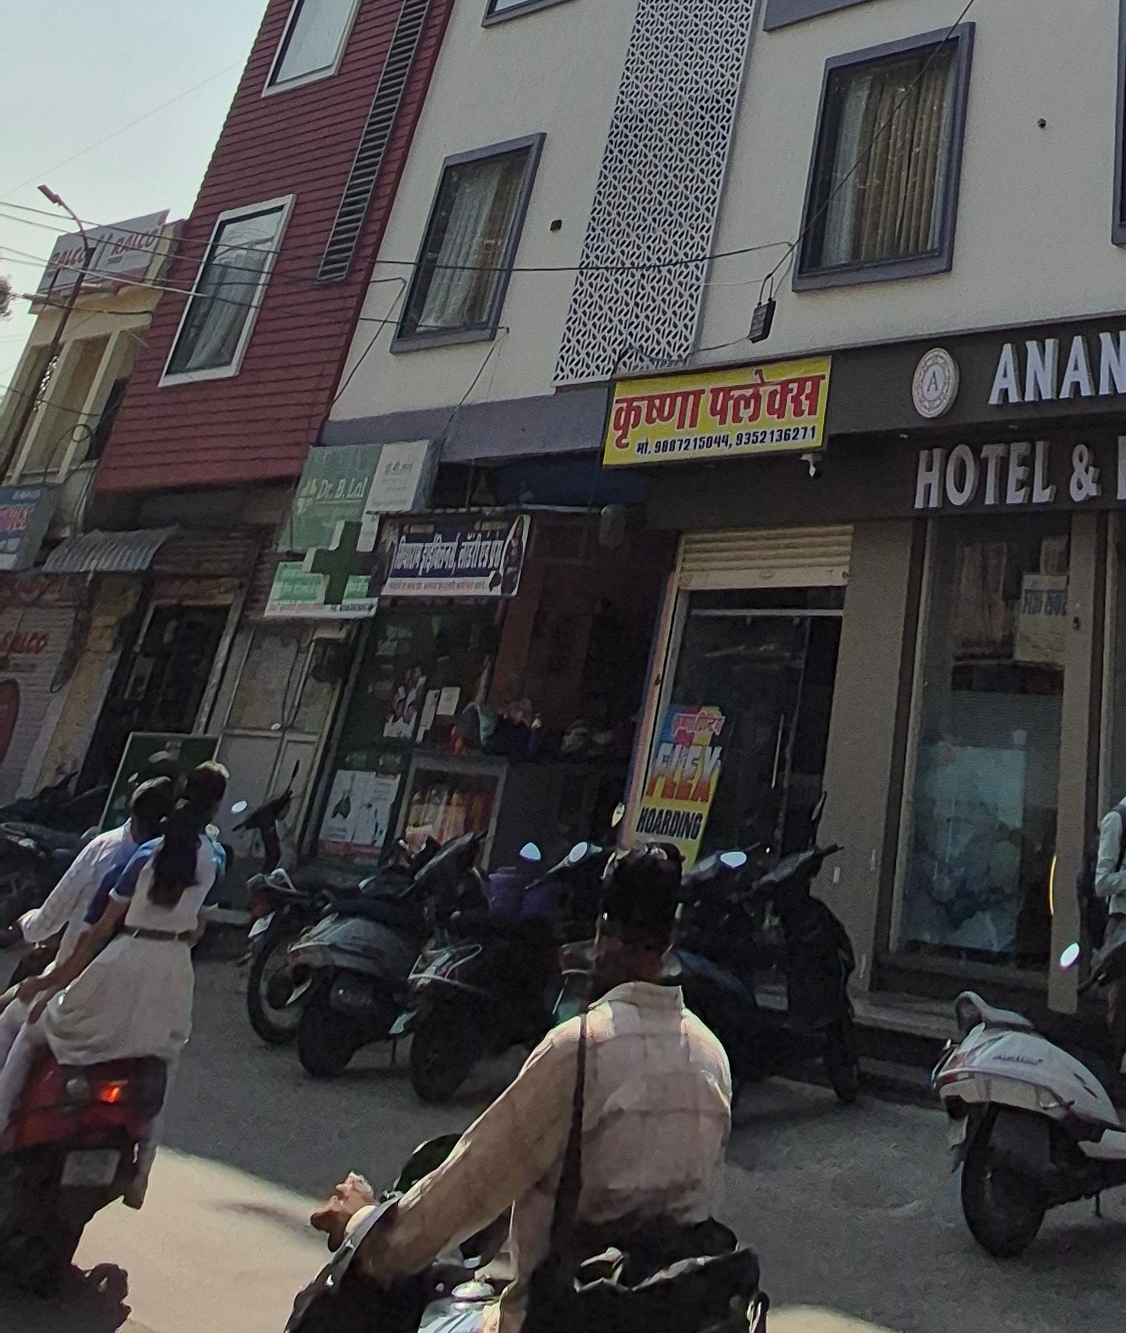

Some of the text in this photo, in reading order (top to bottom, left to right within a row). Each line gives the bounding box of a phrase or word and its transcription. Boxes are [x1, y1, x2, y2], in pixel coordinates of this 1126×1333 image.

[926, 371, 938, 391] A
[612, 369, 826, 450] कृष्णा फ्लेक्स
[736, 425, 817, 447] 9352136271
[913, 440, 1056, 510] HOTEL
[1069, 443, 1100, 503] &
[646, 743, 723, 803] FLEX
[635, 807, 704, 841] HOARDING
